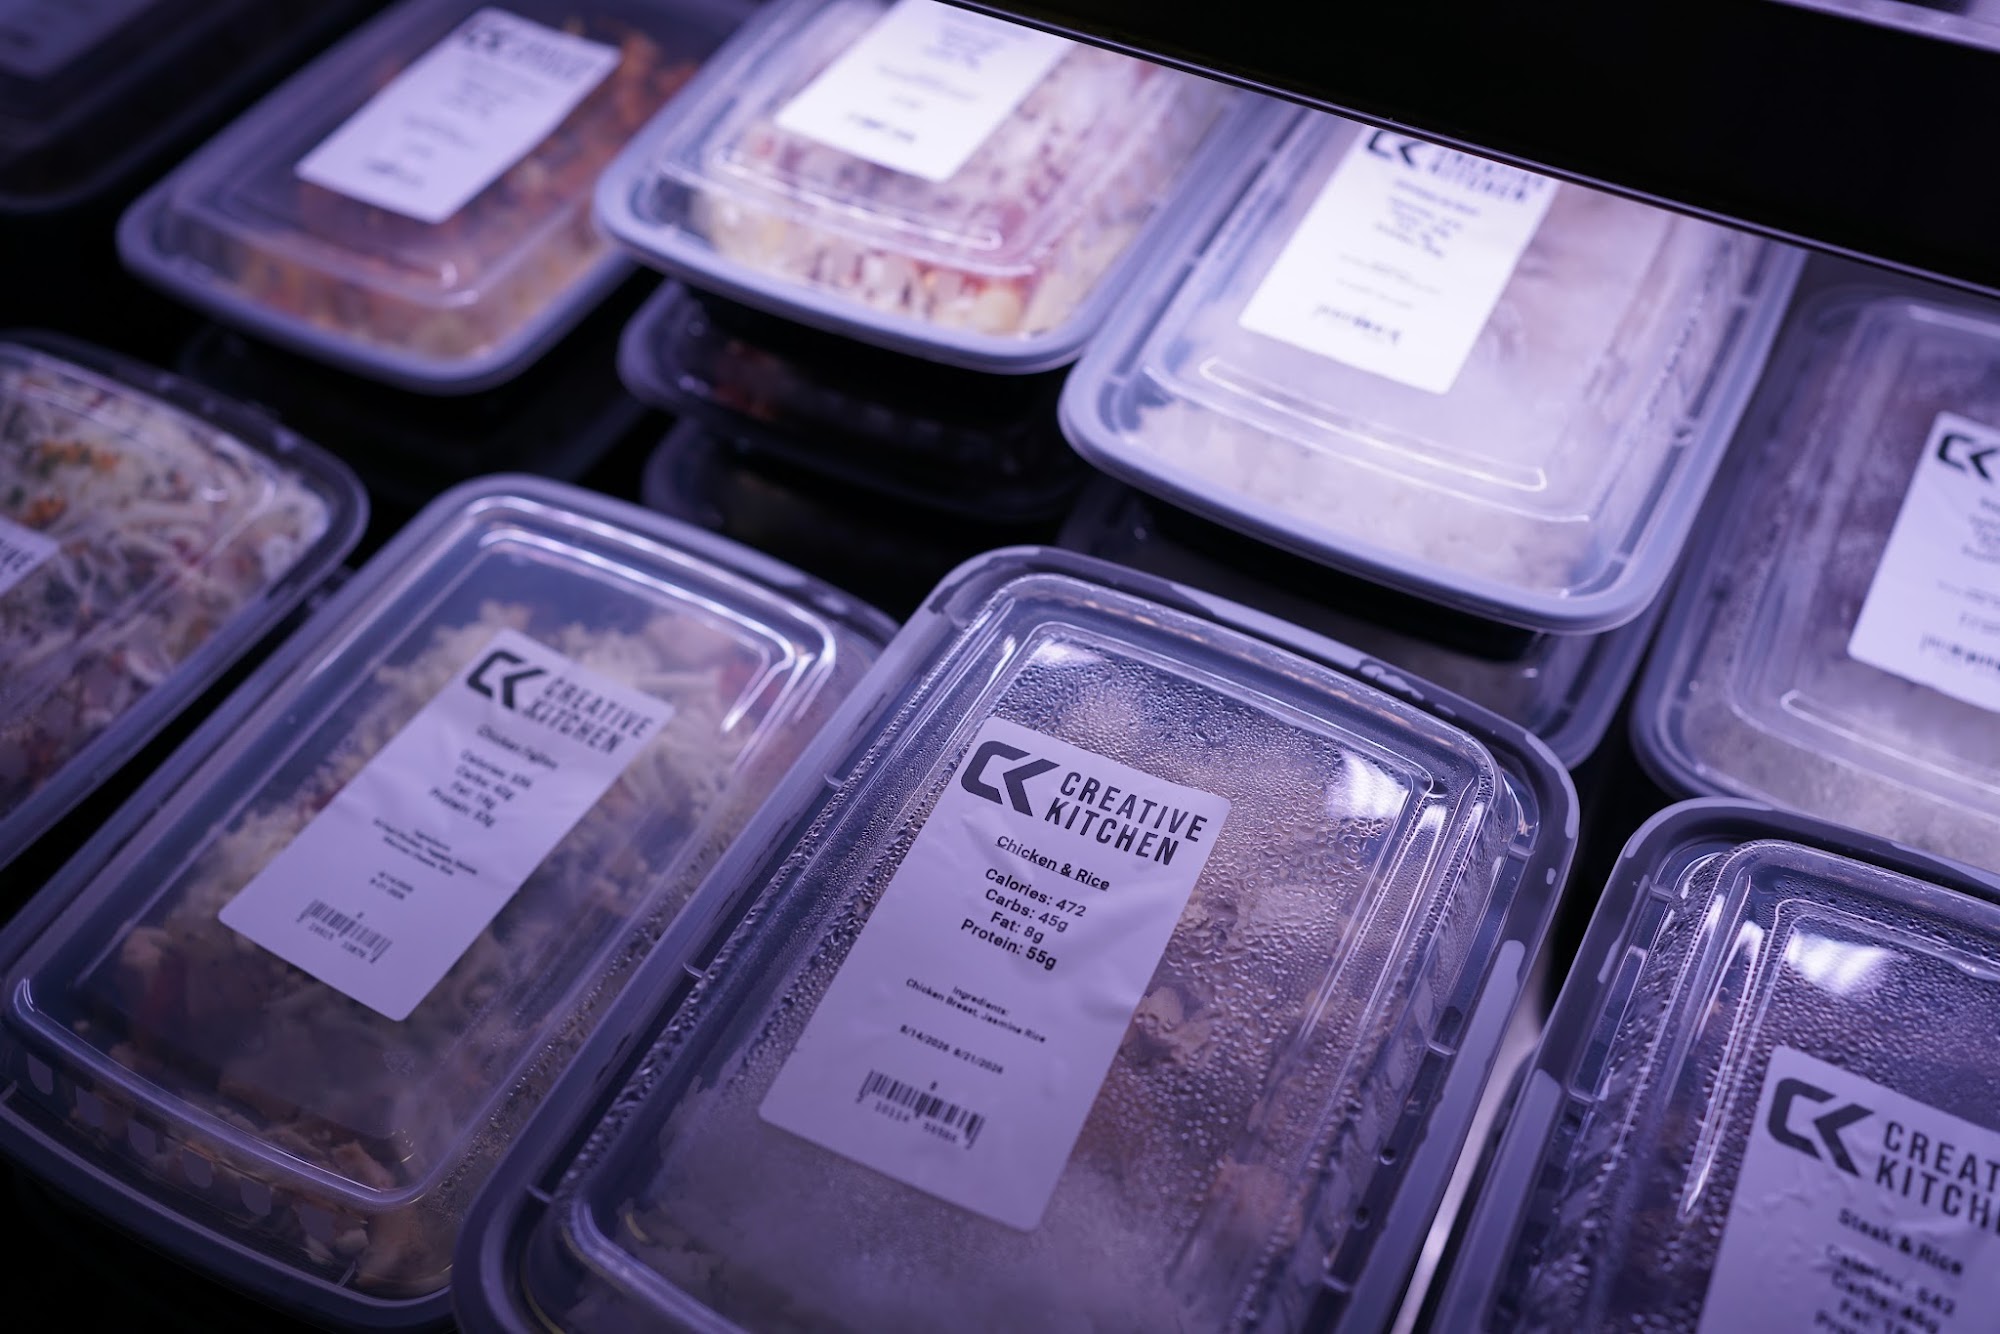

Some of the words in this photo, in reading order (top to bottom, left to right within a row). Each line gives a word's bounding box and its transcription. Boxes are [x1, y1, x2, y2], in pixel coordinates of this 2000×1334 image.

[522, 699, 626, 754] KITCHEN
[543, 677, 653, 738] CREATIVE
[1044, 797, 1179, 866] KITCHEN
[1059, 771, 1208, 842] CREATIVE
[996, 835, 1057, 873] Chicken
[1061, 863, 1073, 877] &
[1075, 868, 1110, 891] Rice
[985, 868, 1053, 905] Calories:
[1055, 899, 1087, 917] 472
[985, 888, 1035, 918] Carbs:
[1038, 913, 1068, 933] 45g
[961, 918, 1023, 955] Protein:
[1026, 946, 1057, 971] 55g
[990, 911, 1021, 933] Fat:
[1023, 925, 1045, 944] 8g
[906, 978, 944, 1002] Chicken
[946, 996, 978, 1018] Breast,
[980, 1012, 1022, 1035] Jasmine
[1024, 1028, 1046, 1043] Rice
[952, 986, 1009, 1016] Ingredients:
[1884, 1121, 2000, 1193] CREAT
[1876, 1154, 2000, 1235] KITCH
[1838, 1207, 1892, 1246] Steak
[1899, 1235, 1912, 1254] &
[1917, 1243, 1963, 1276] Rice
